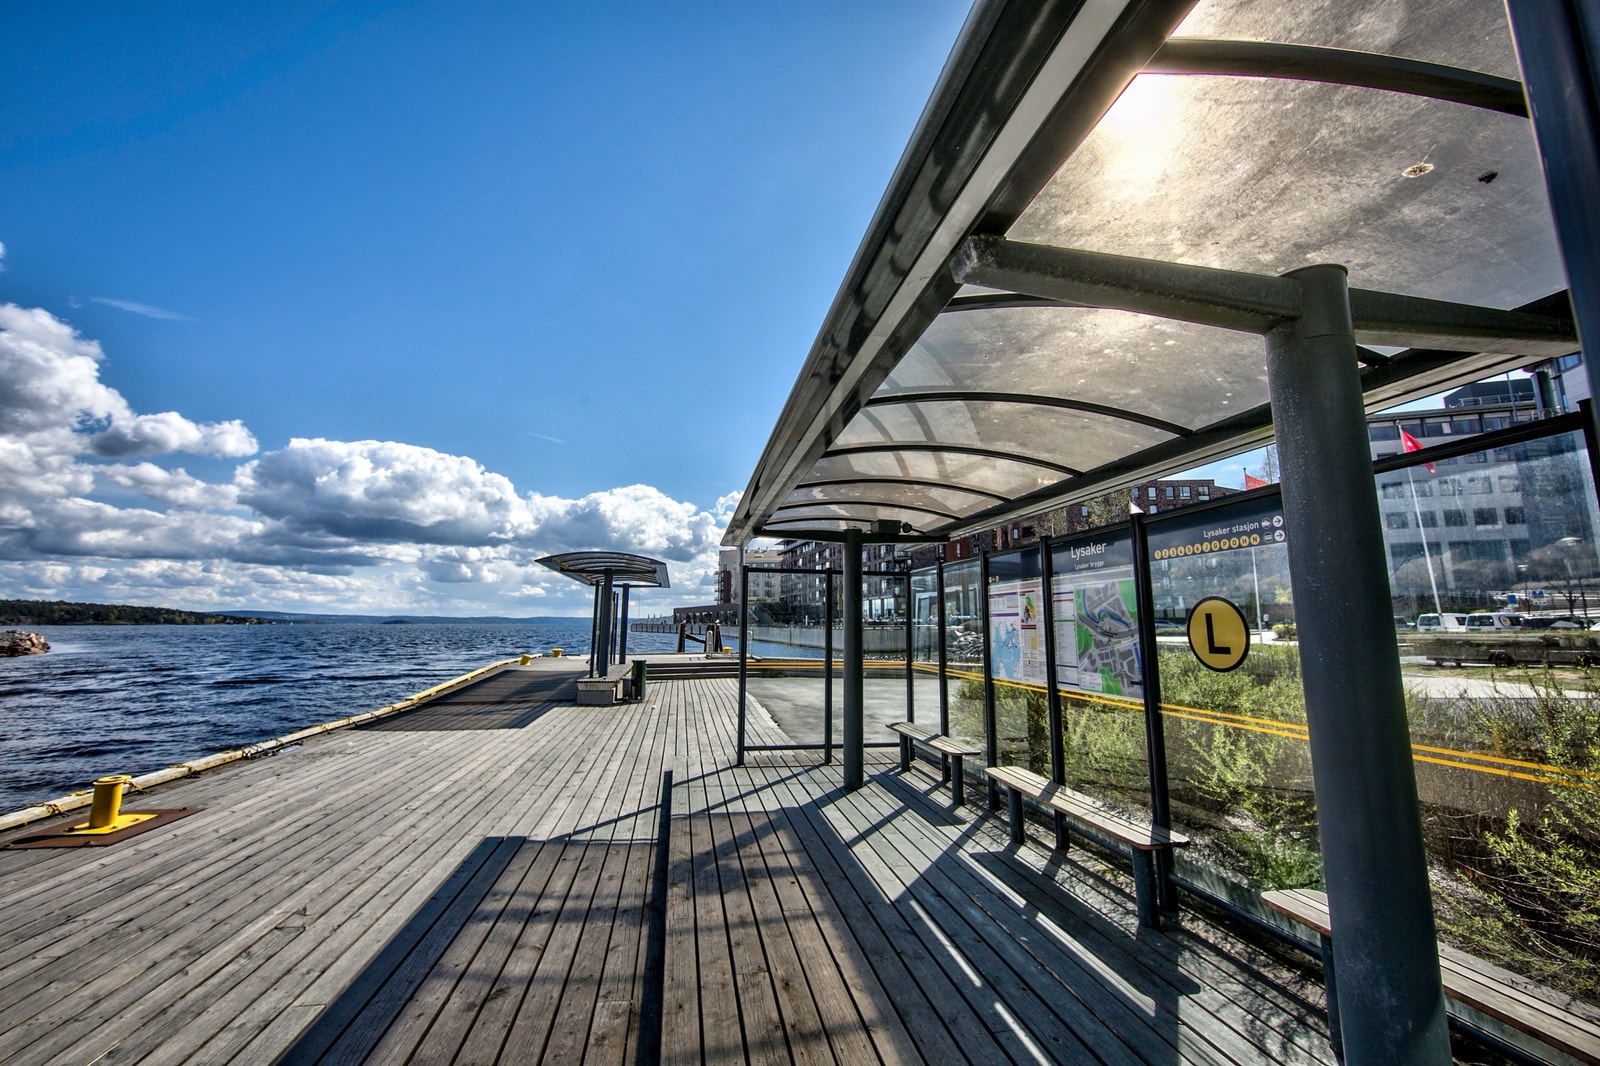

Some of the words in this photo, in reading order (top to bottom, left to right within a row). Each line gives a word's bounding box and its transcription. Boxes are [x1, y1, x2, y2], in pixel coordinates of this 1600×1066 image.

[1203, 526, 1230, 539] Lysaker
[1232, 521, 1259, 533] stasjon
[1070, 542, 1107, 560] Lysaker
[1204, 612, 1232, 655] L
